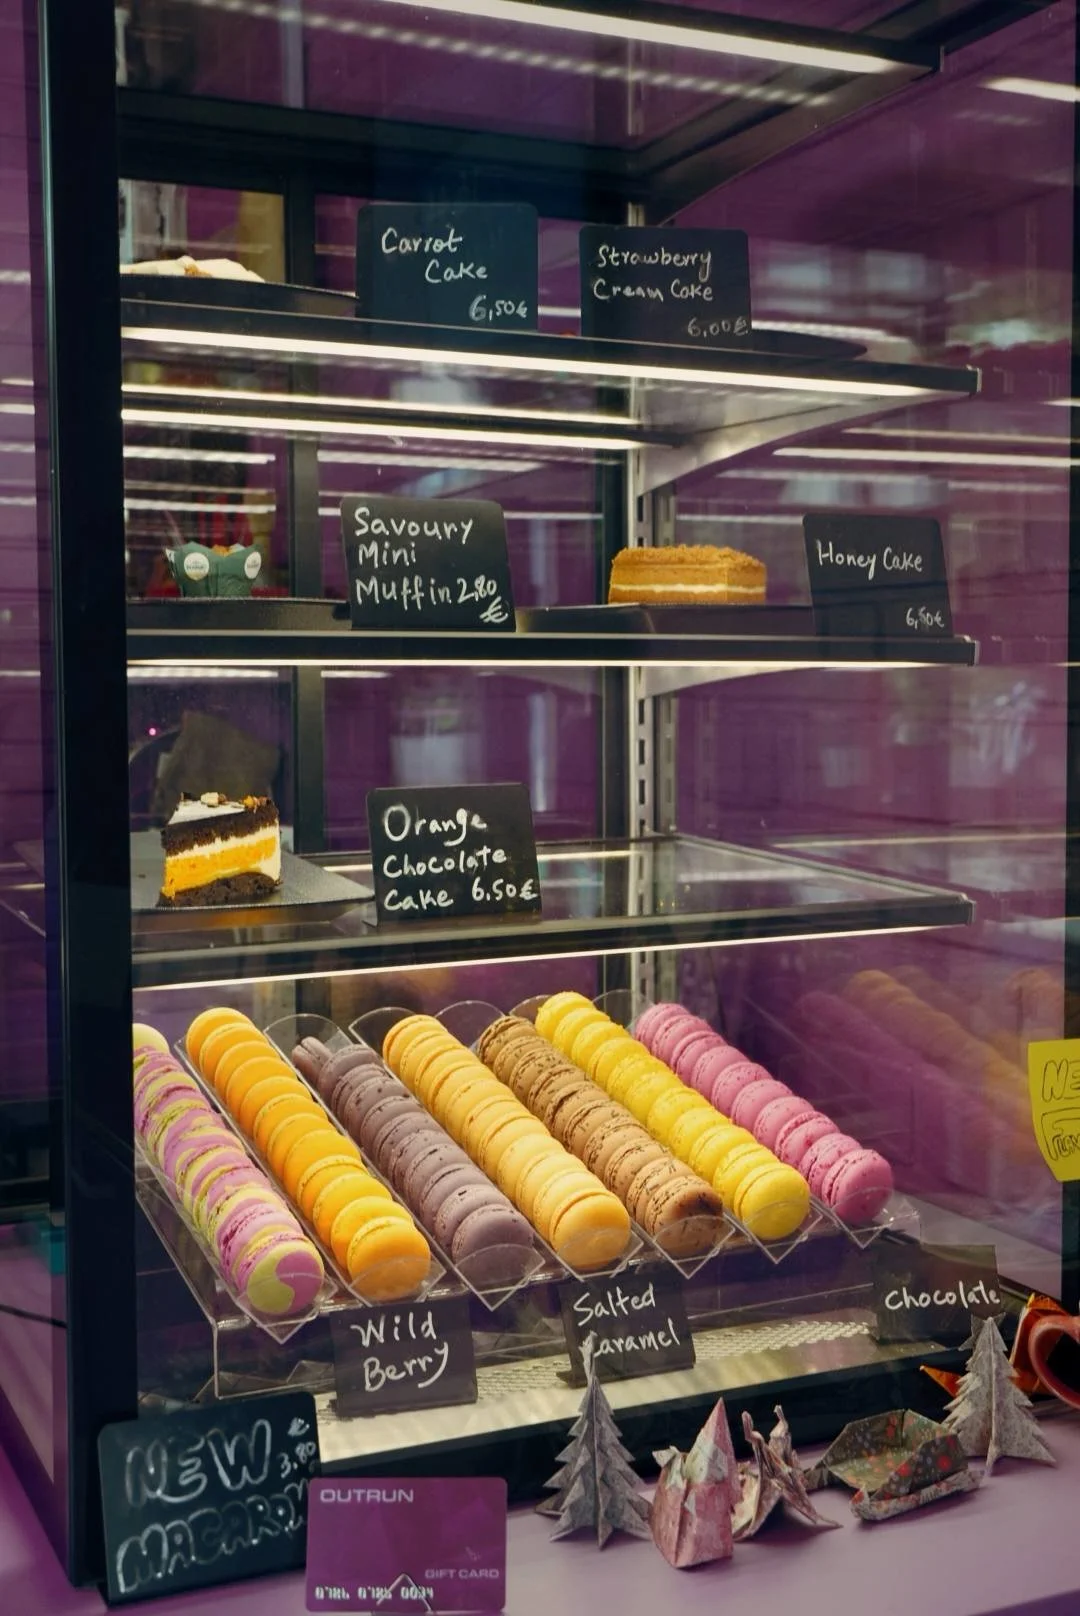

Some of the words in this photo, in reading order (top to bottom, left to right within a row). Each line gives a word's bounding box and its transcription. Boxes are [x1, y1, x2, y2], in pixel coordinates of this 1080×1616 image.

[381, 226, 463, 253] Carrot
[425, 258, 488, 284] Cake
[597, 244, 712, 282] Strawberry
[592, 278, 664, 302] Cream
[670, 278, 714, 301] Cake
[468, 294, 528, 321] 6,50€
[353, 506, 474, 545] Savoury
[358, 540, 416, 568] Mini
[815, 538, 877, 580] Honey
[882, 546, 924, 572] Cake
[355, 575, 453, 611] Muffin
[383, 804, 488, 847] Orange
[382, 845, 507, 878] Chocolate
[383, 888, 454, 910] Cake
[573, 1282, 656, 1326] Salted
[884, 1280, 1000, 1310] Chocolate
[351, 1311, 437, 1347] Wild
[580, 1317, 680, 1358] aramel
[363, 1342, 449, 1392] Berry
[320, 1488, 414, 1503] OUTRUN
[424, 1568, 456, 1579] GIFT
[458, 1568, 500, 1579] CARD
